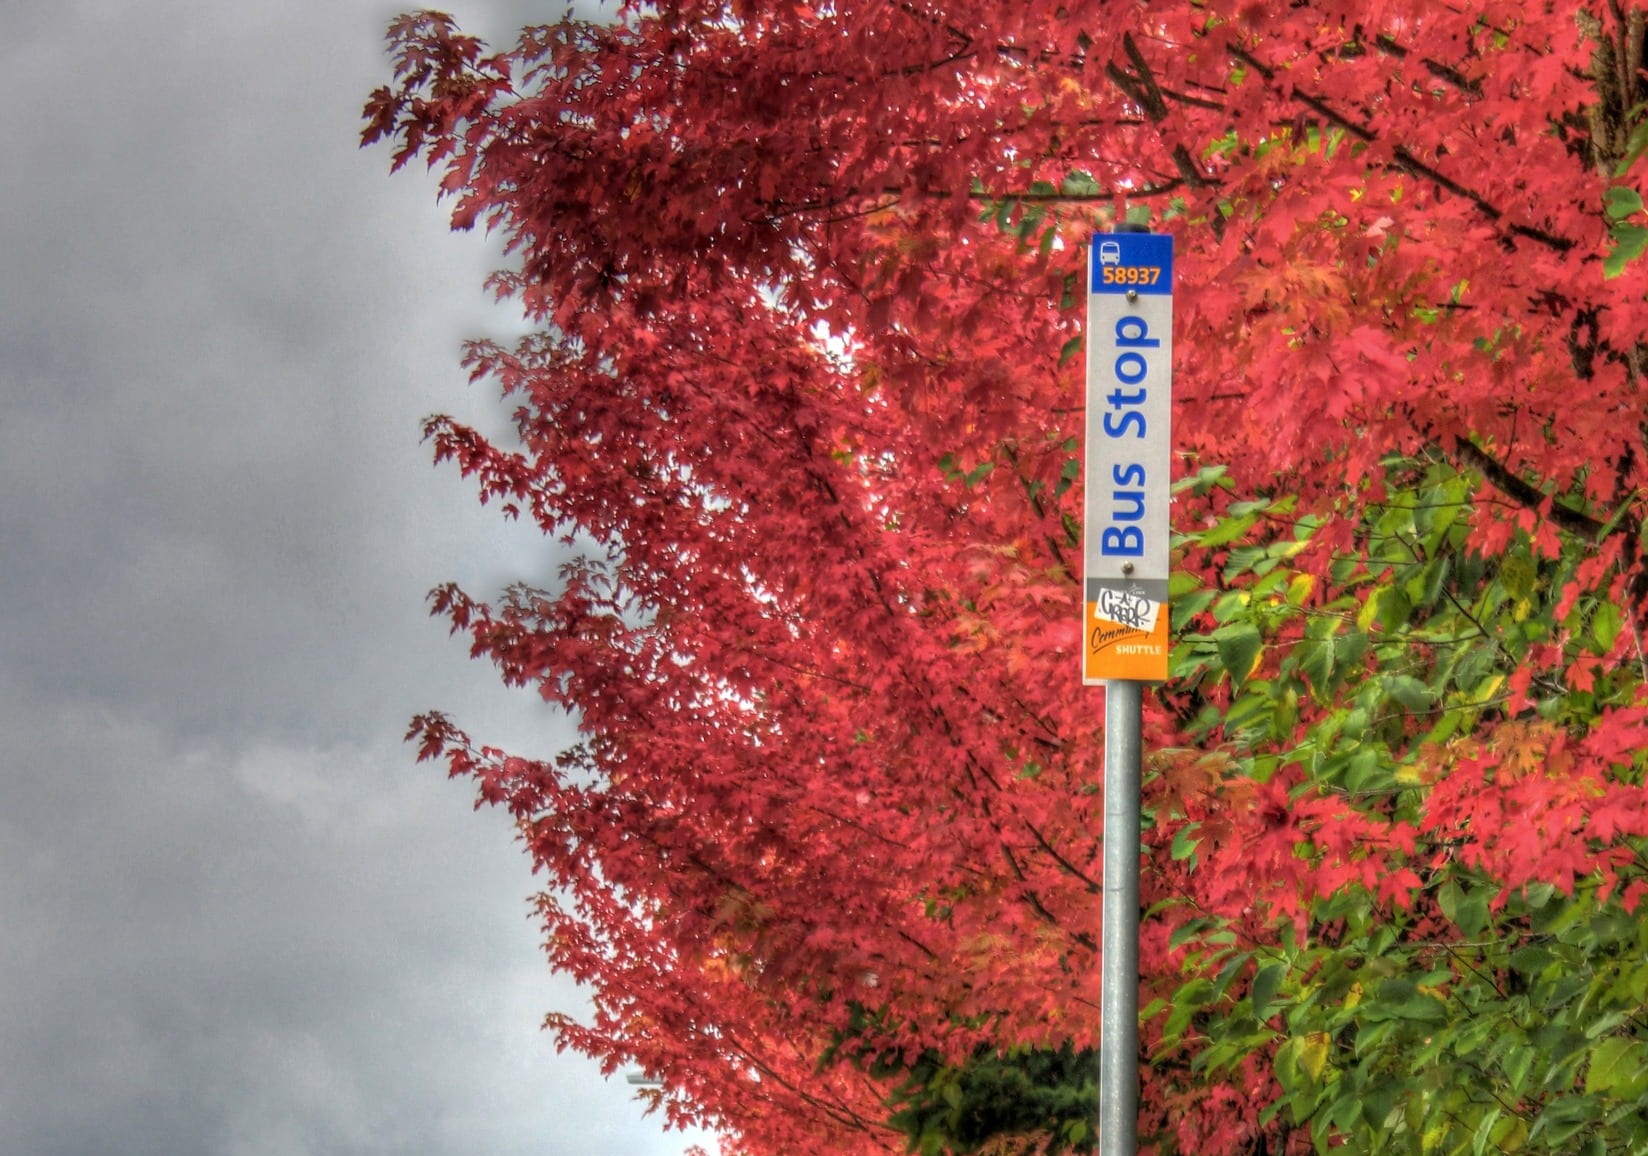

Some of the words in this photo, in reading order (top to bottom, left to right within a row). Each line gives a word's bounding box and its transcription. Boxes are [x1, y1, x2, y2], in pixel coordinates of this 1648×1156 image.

[1103, 266, 1161, 285] 58937
[1103, 315, 1160, 439] Stop
[1101, 463, 1147, 557] Bus
[1091, 626, 1149, 648] Commu
[1116, 645, 1162, 654] SHUTTLE
